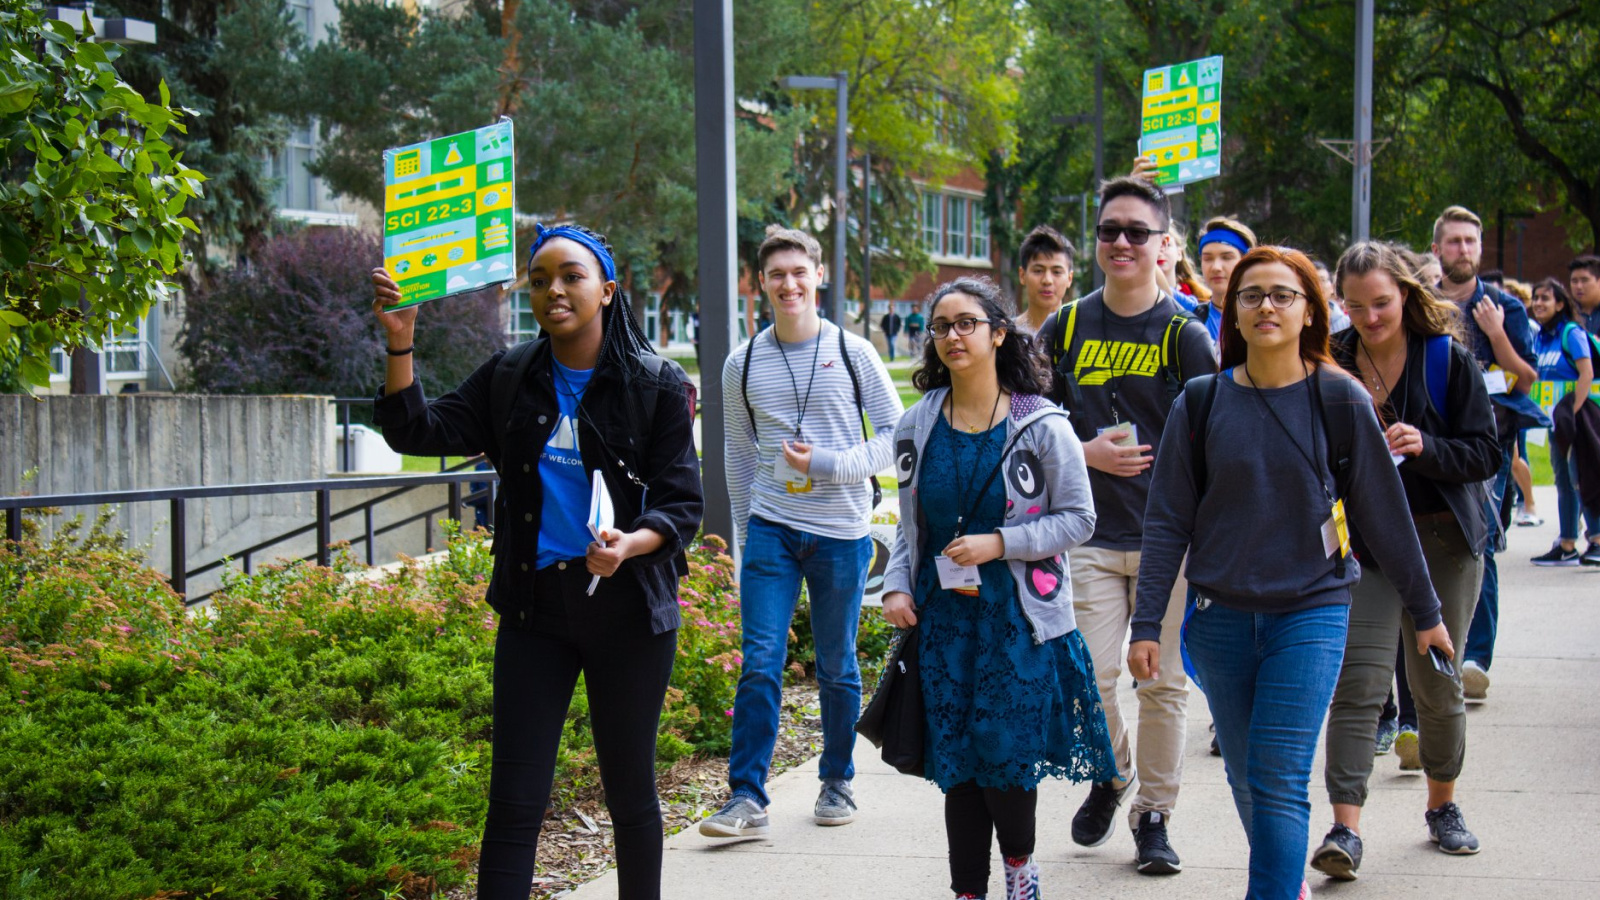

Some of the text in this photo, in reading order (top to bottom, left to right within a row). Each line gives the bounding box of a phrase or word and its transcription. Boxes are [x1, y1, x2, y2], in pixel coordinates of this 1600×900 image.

[1143, 111, 1195, 132] SCI 22-3
[387, 198, 472, 231] SCI 22-3
[1074, 340, 1160, 381] PUMA
